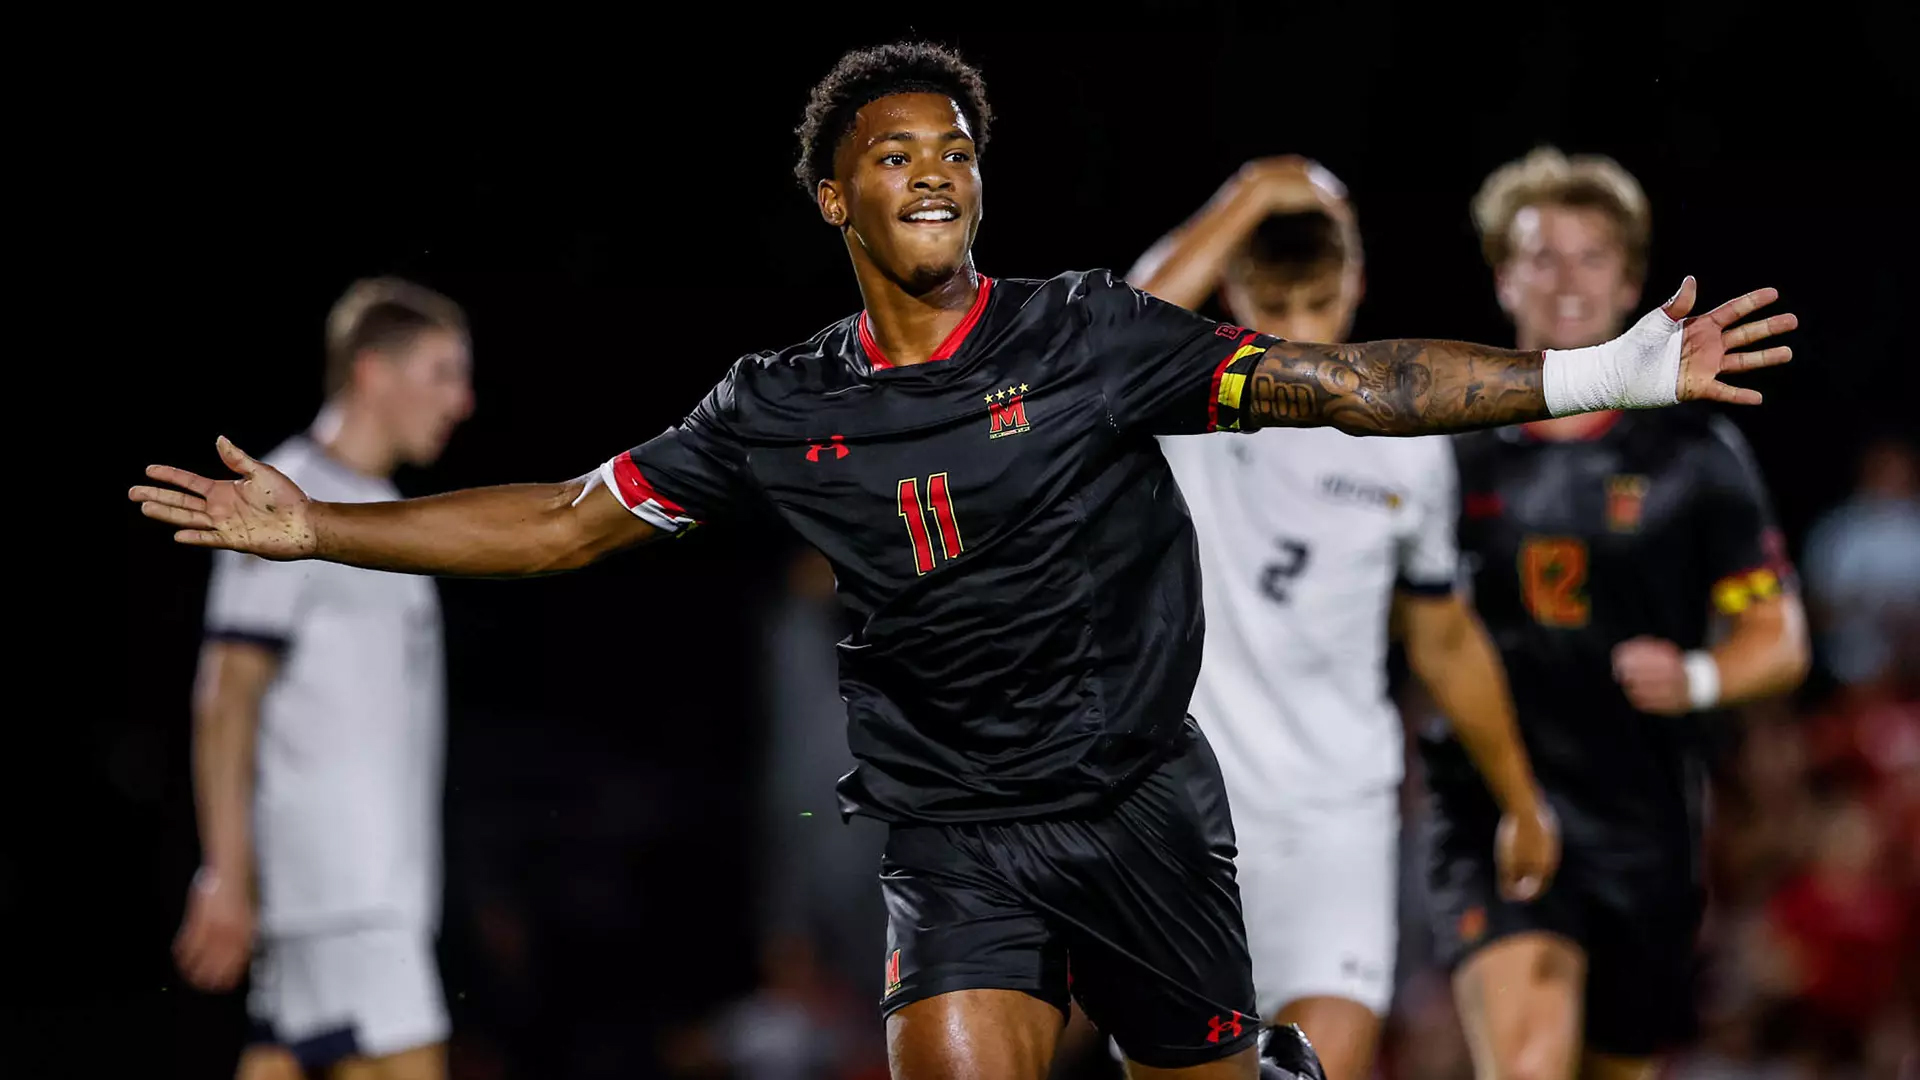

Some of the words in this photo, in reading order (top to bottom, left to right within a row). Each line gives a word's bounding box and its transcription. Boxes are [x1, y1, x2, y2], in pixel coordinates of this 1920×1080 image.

[988, 394, 1030, 434] M
[896, 471, 965, 576] 11
[1259, 539, 1308, 605] 2
[1519, 537, 1591, 627] 12
